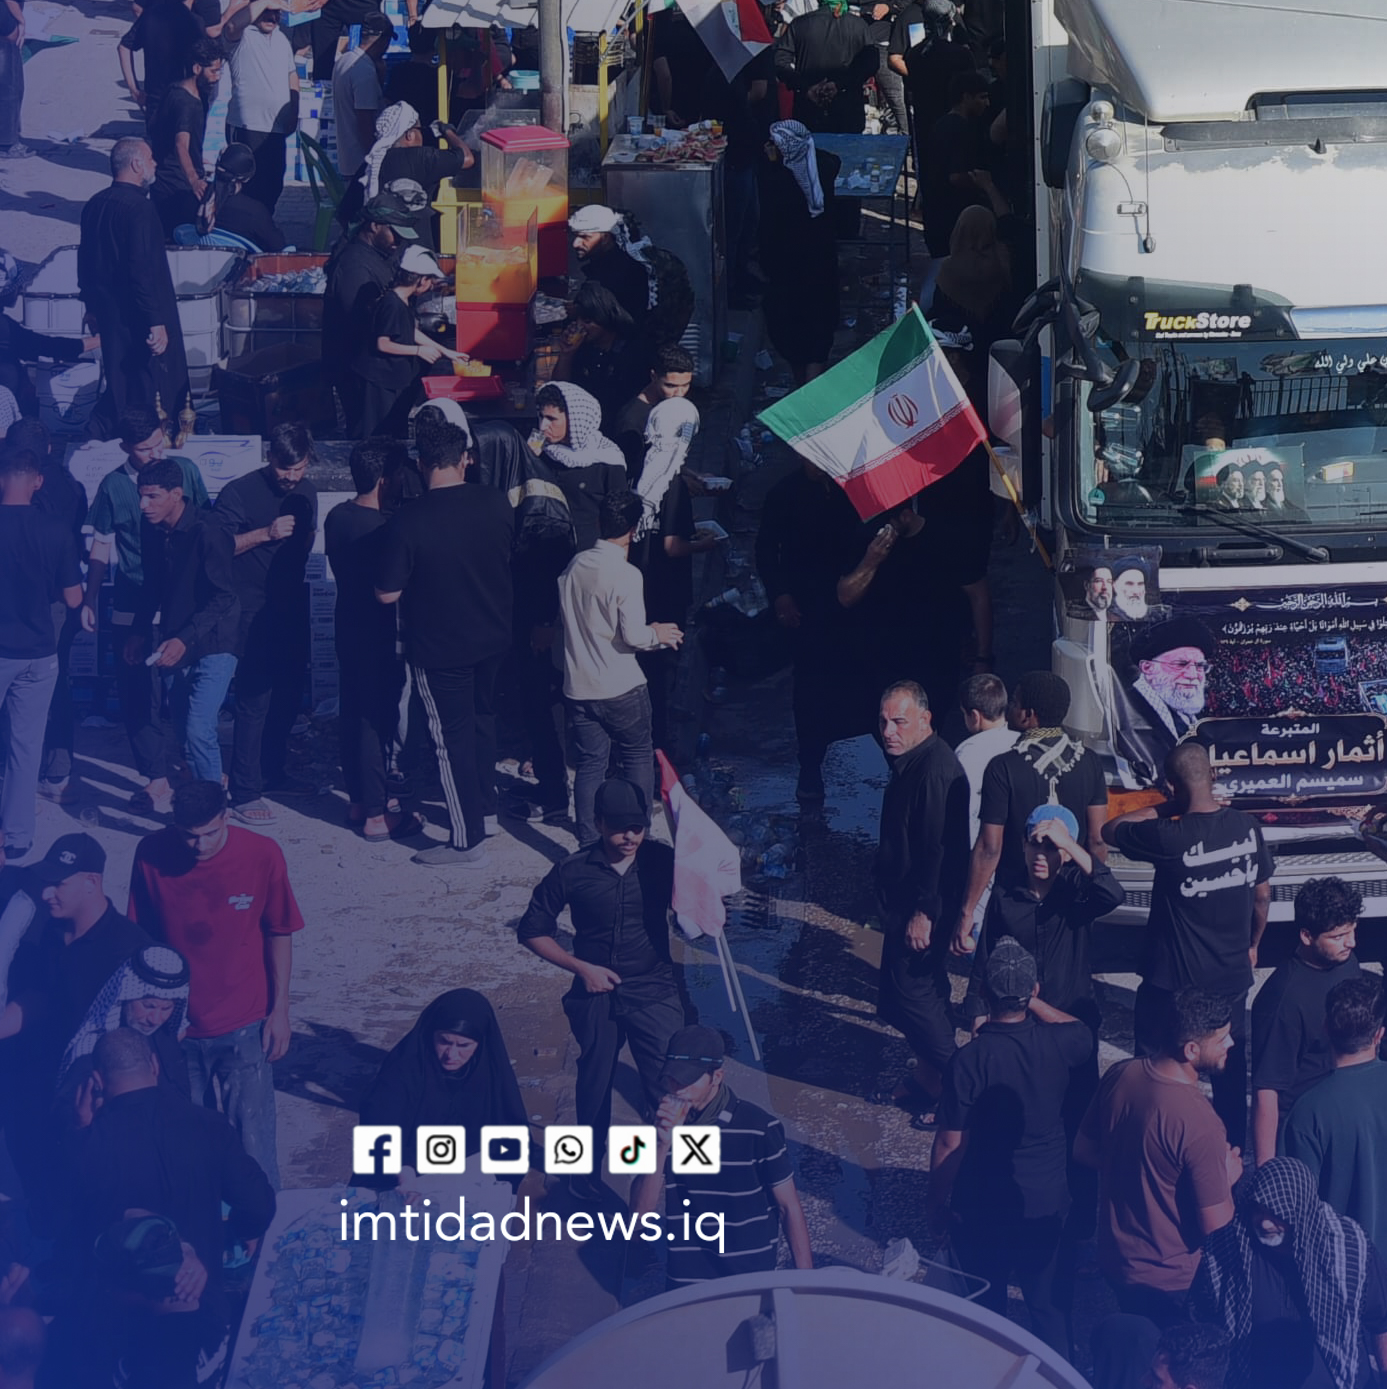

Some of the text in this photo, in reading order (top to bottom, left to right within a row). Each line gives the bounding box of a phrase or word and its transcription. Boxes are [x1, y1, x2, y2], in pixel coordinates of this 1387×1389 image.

[1143, 311, 1253, 331] TruckStore
[1314, 354, 1334, 369] الله
[1261, 723, 1320, 738] المتبرعة
[1320, 731, 1385, 770] أثمار
